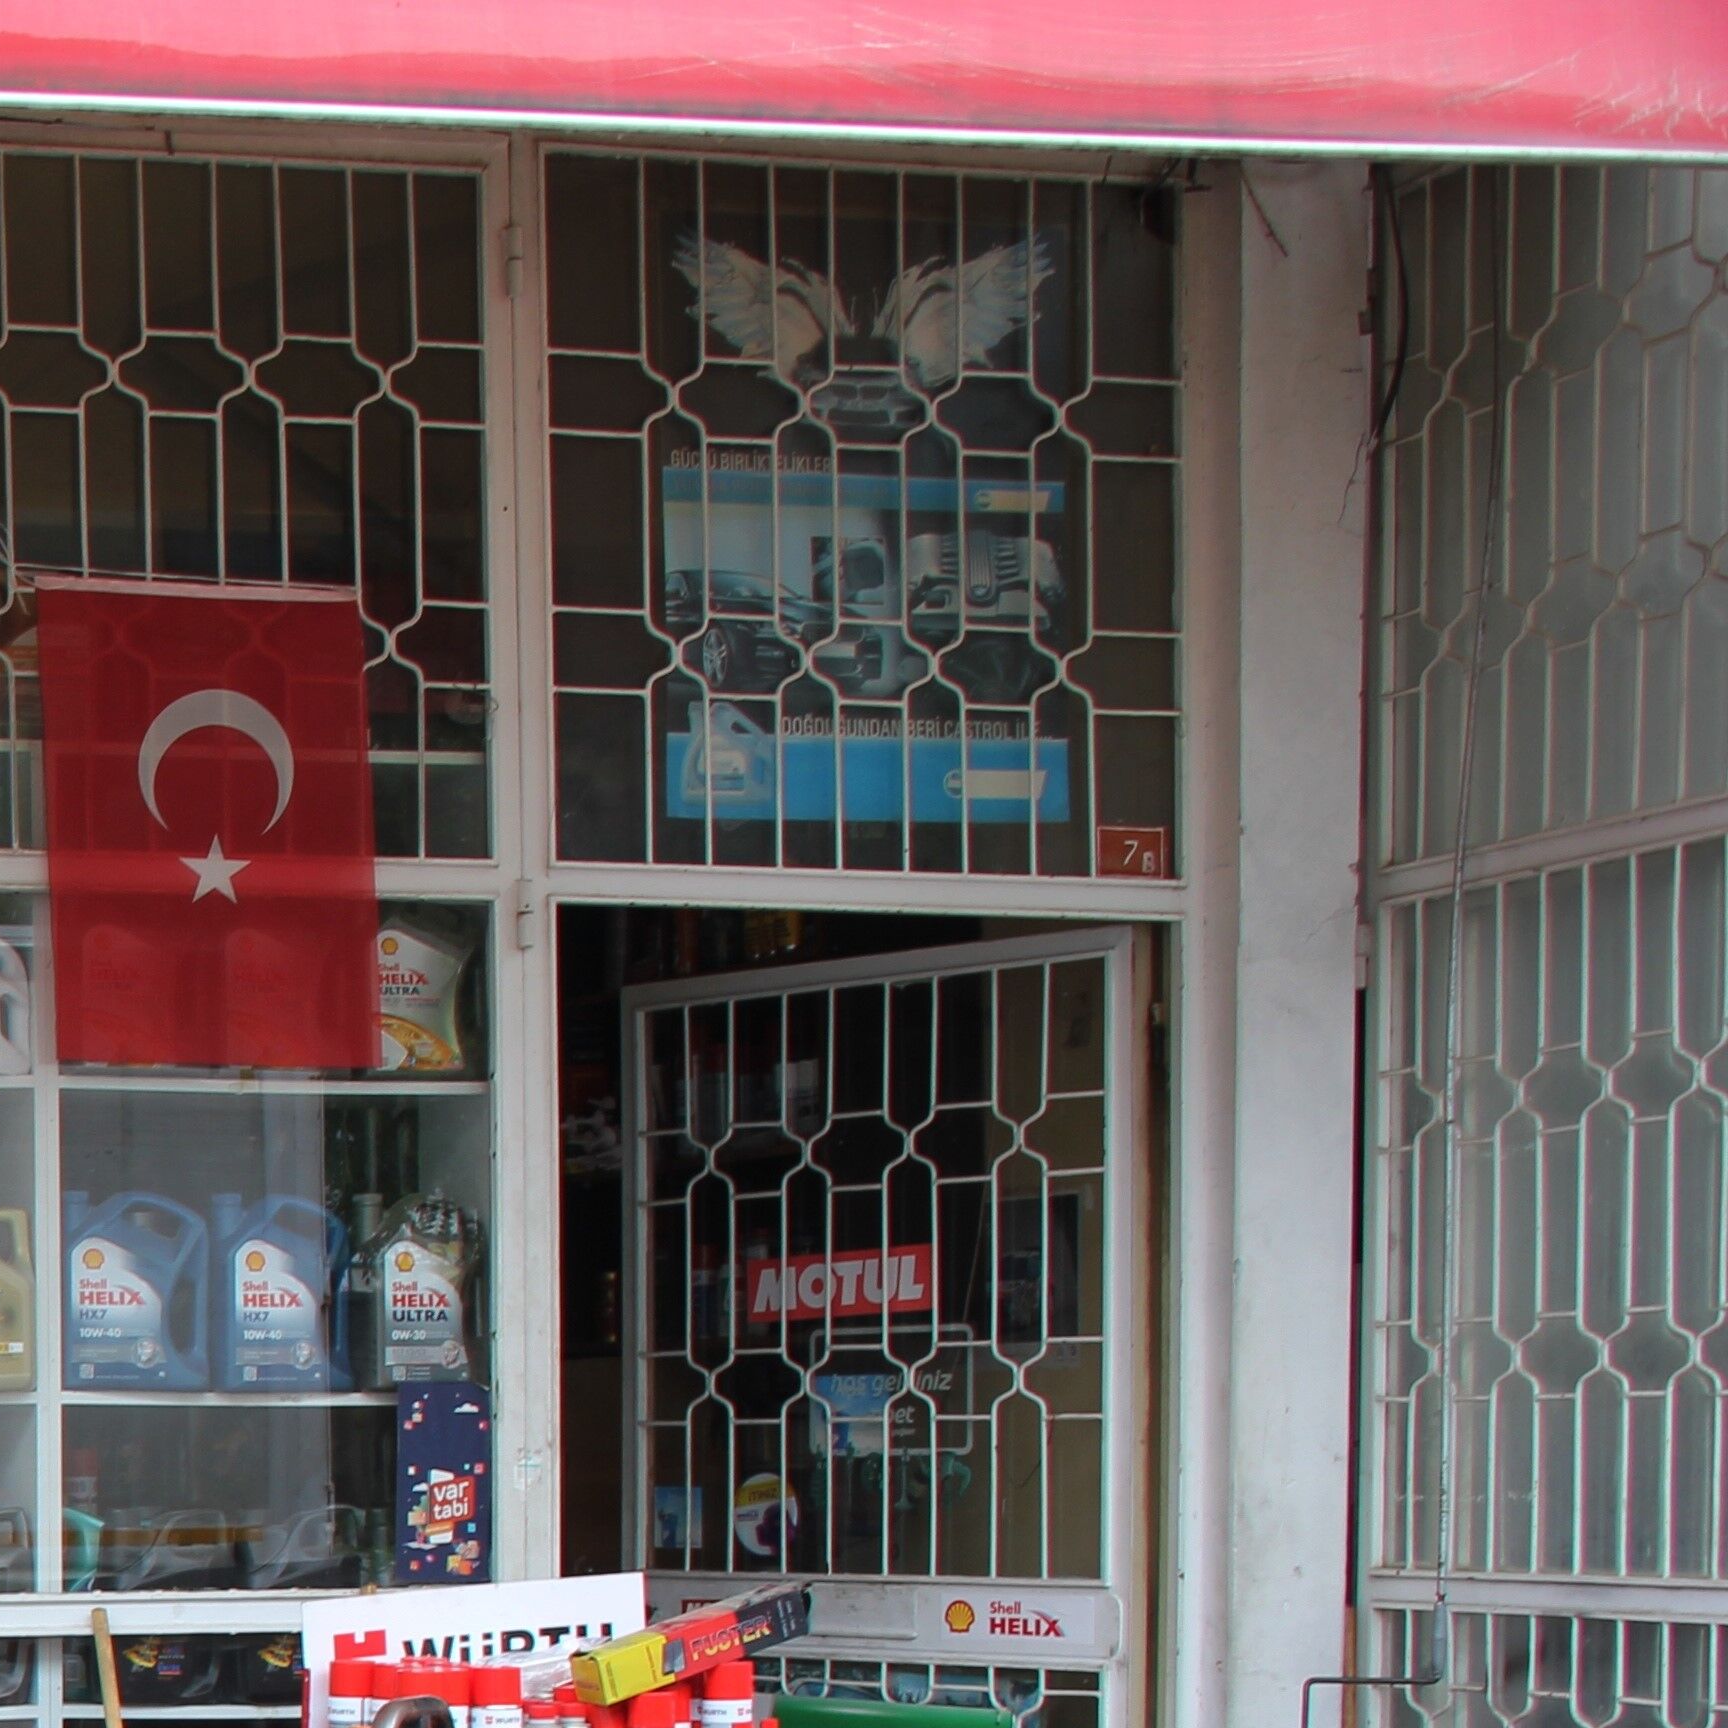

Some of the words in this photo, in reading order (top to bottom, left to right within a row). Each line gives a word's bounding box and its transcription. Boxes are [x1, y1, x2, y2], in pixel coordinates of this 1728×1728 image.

[1122, 839, 1138, 866] 7
[377, 963, 400, 973] Shell
[378, 971, 430, 986] HELIX
[378, 985, 420, 996] ULTRA
[79, 1279, 108, 1291] Shell
[243, 1281, 269, 1293] Shell
[391, 1280, 418, 1293] Shell
[751, 1253, 925, 1316] MOTUL
[79, 1289, 146, 1306] HELIX
[243, 1291, 303, 1308] HELIX
[391, 1292, 451, 1308] HELIX
[79, 1309, 107, 1321] HX7
[243, 1311, 269, 1323] HX7
[392, 1309, 448, 1323] ULTRA
[433, 1481, 469, 1502] var
[433, 1497, 469, 1520] tabi
[989, 1602, 1022, 1616] Shell
[989, 1613, 1064, 1638] HELIX
